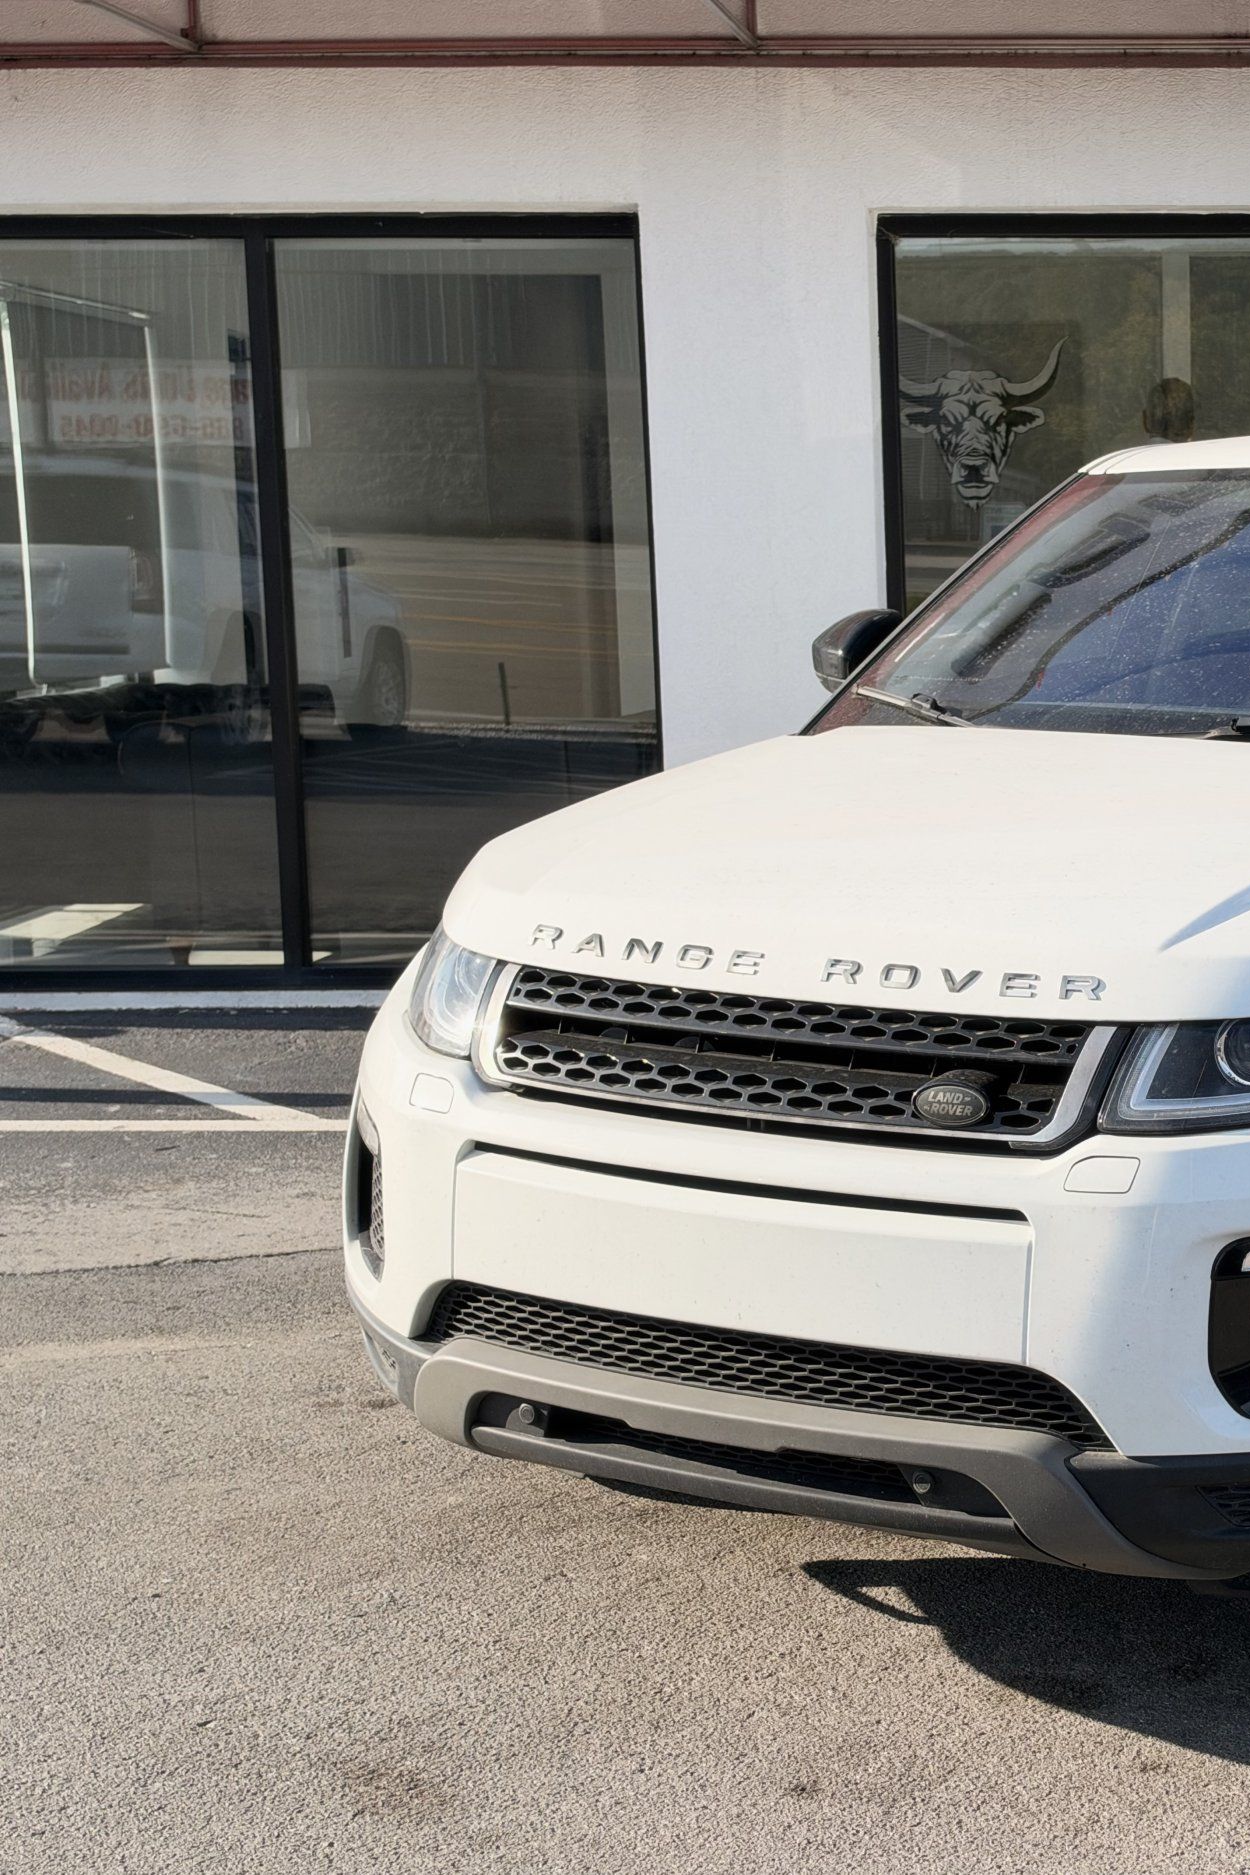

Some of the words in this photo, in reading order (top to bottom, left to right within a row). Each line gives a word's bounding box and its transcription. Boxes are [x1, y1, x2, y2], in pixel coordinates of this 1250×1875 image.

[532, 923, 765, 975] RANGE
[820, 958, 1108, 1001] ROVER
[928, 1091, 963, 1104] LAND
[930, 1103, 973, 1116] ROVER
